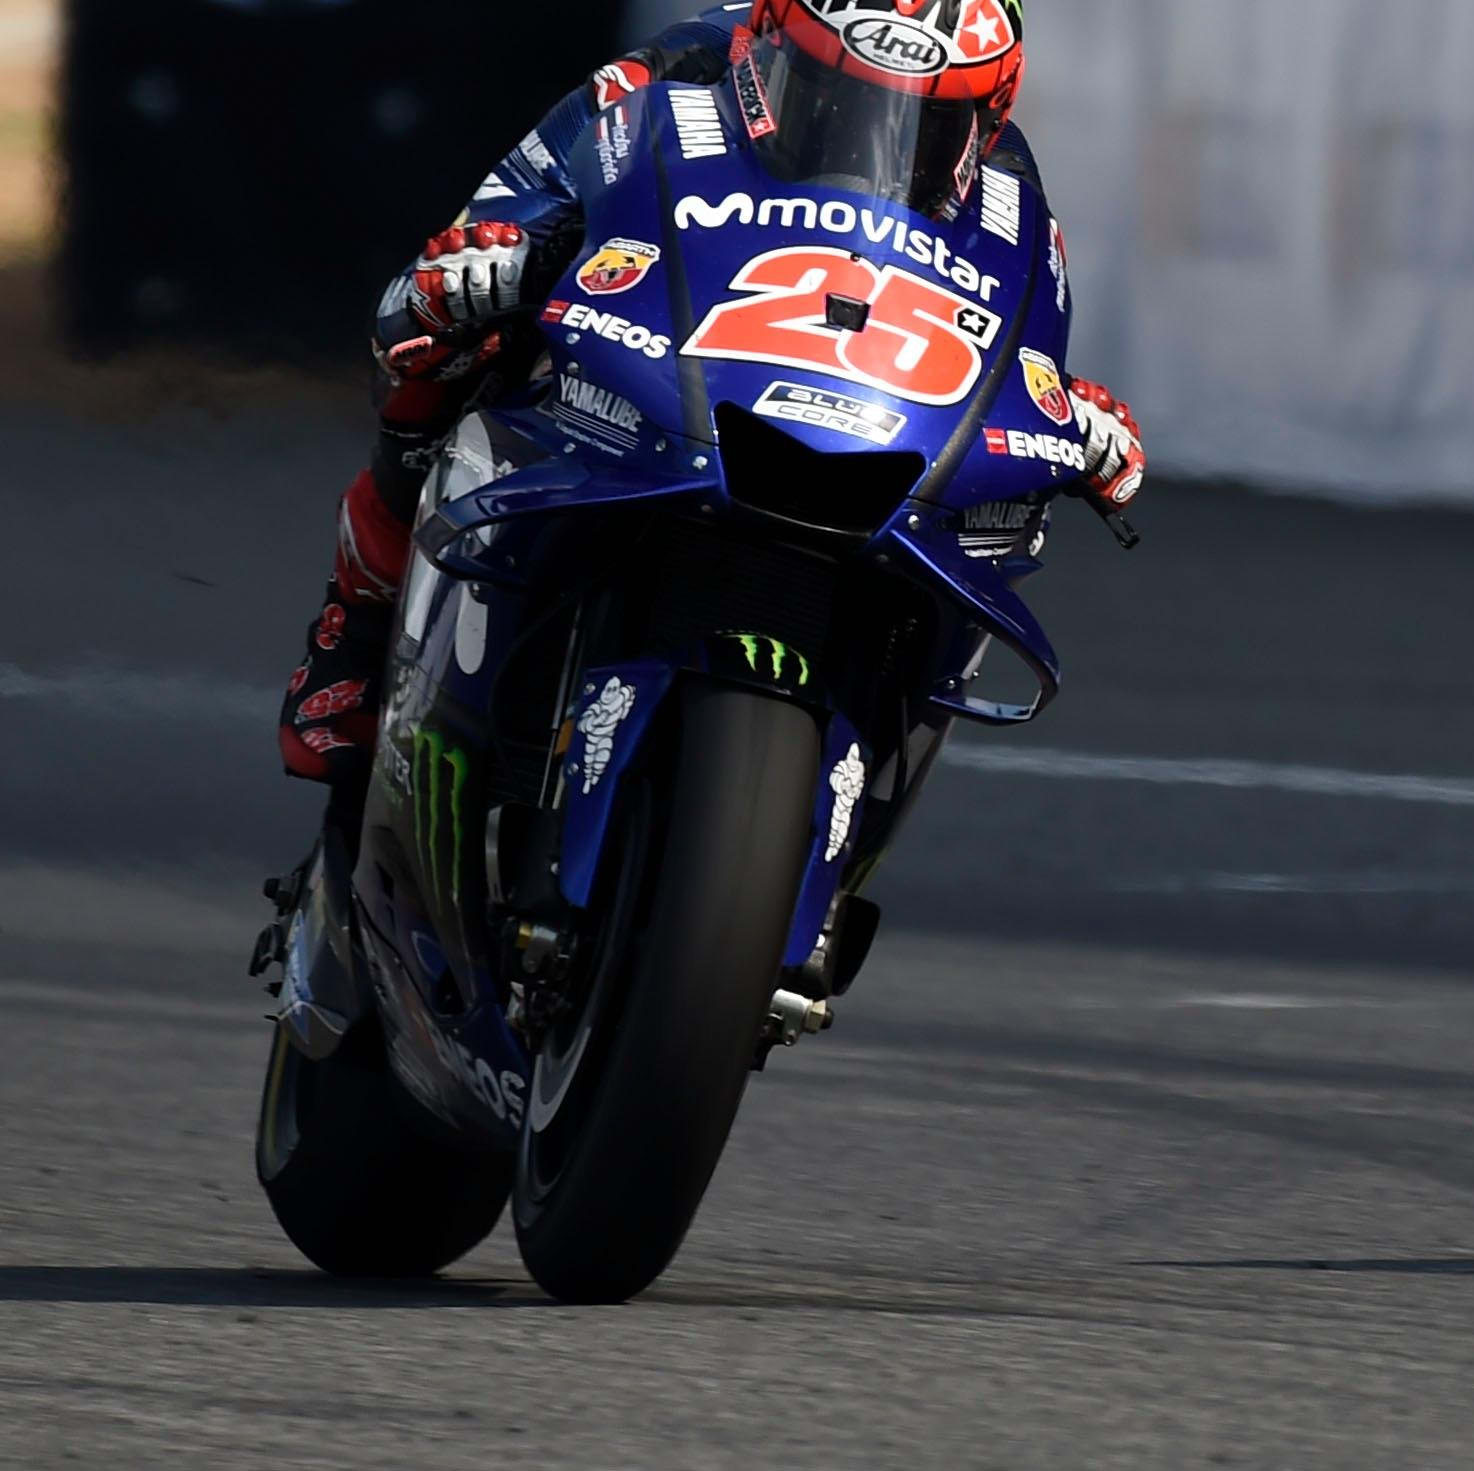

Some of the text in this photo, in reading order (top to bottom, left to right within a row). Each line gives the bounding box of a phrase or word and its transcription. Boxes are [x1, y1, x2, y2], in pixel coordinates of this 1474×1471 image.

[850, 24, 937, 64] Arai
[667, 89, 727, 160] YAMAHA
[980, 164, 1020, 246] YAMAHA
[757, 197, 1001, 302] movistar
[561, 303, 671, 359] ENEOS
[678, 244, 1002, 407] 25
[559, 373, 643, 433] YAMALUBE
[777, 404, 873, 435] CORE
[1006, 429, 1086, 472] ENEOS
